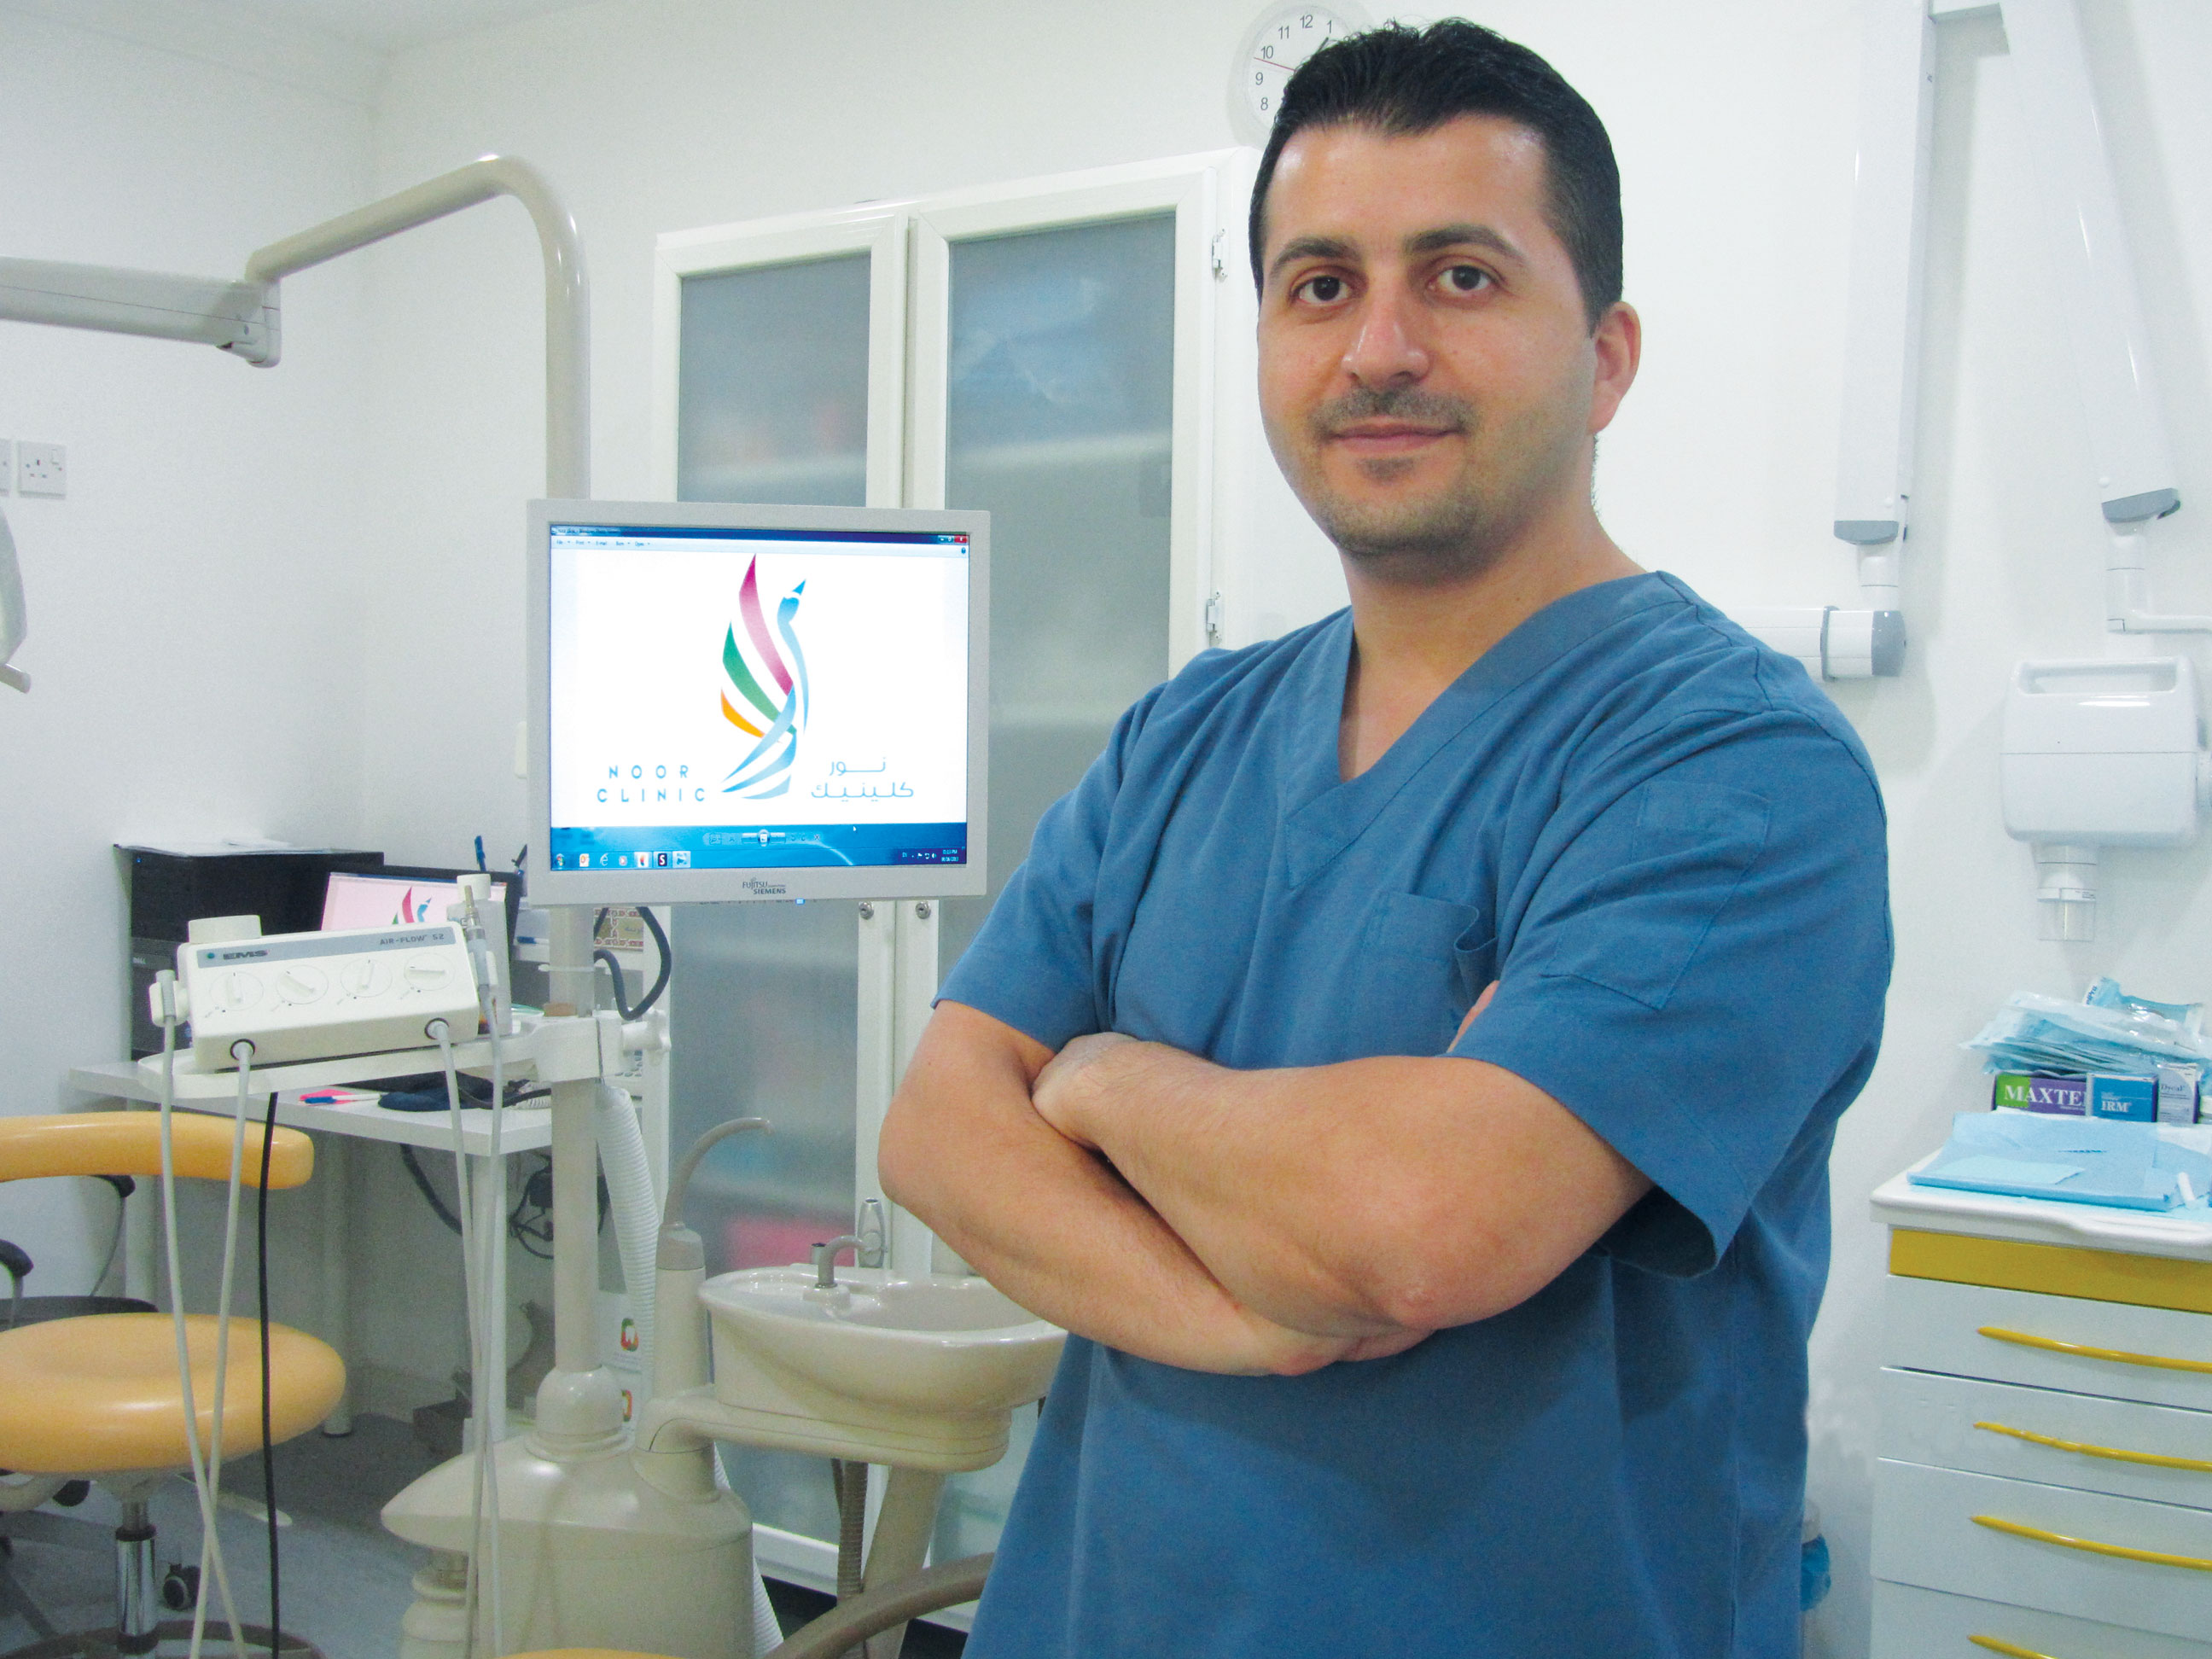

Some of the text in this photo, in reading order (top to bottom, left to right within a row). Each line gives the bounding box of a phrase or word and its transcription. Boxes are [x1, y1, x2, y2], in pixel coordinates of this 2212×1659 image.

[1300, 15, 1313, 29] 12
[1327, 20, 1332, 33] 1
[1278, 26, 1289, 39] 11
[1260, 45, 1274, 59] 10
[1255, 72, 1264, 85] 9
[1260, 97, 1268, 111] 8
[608, 765, 689, 779] NOOR
[830, 756, 886, 777] نور
[597, 788, 705, 803] CLINIC
[811, 782, 914, 802] كلينيك
[742, 878, 768, 889] FUJITSU
[2004, 1085, 2087, 1106] MAXTE
[2101, 1100, 2129, 1113] IRM
